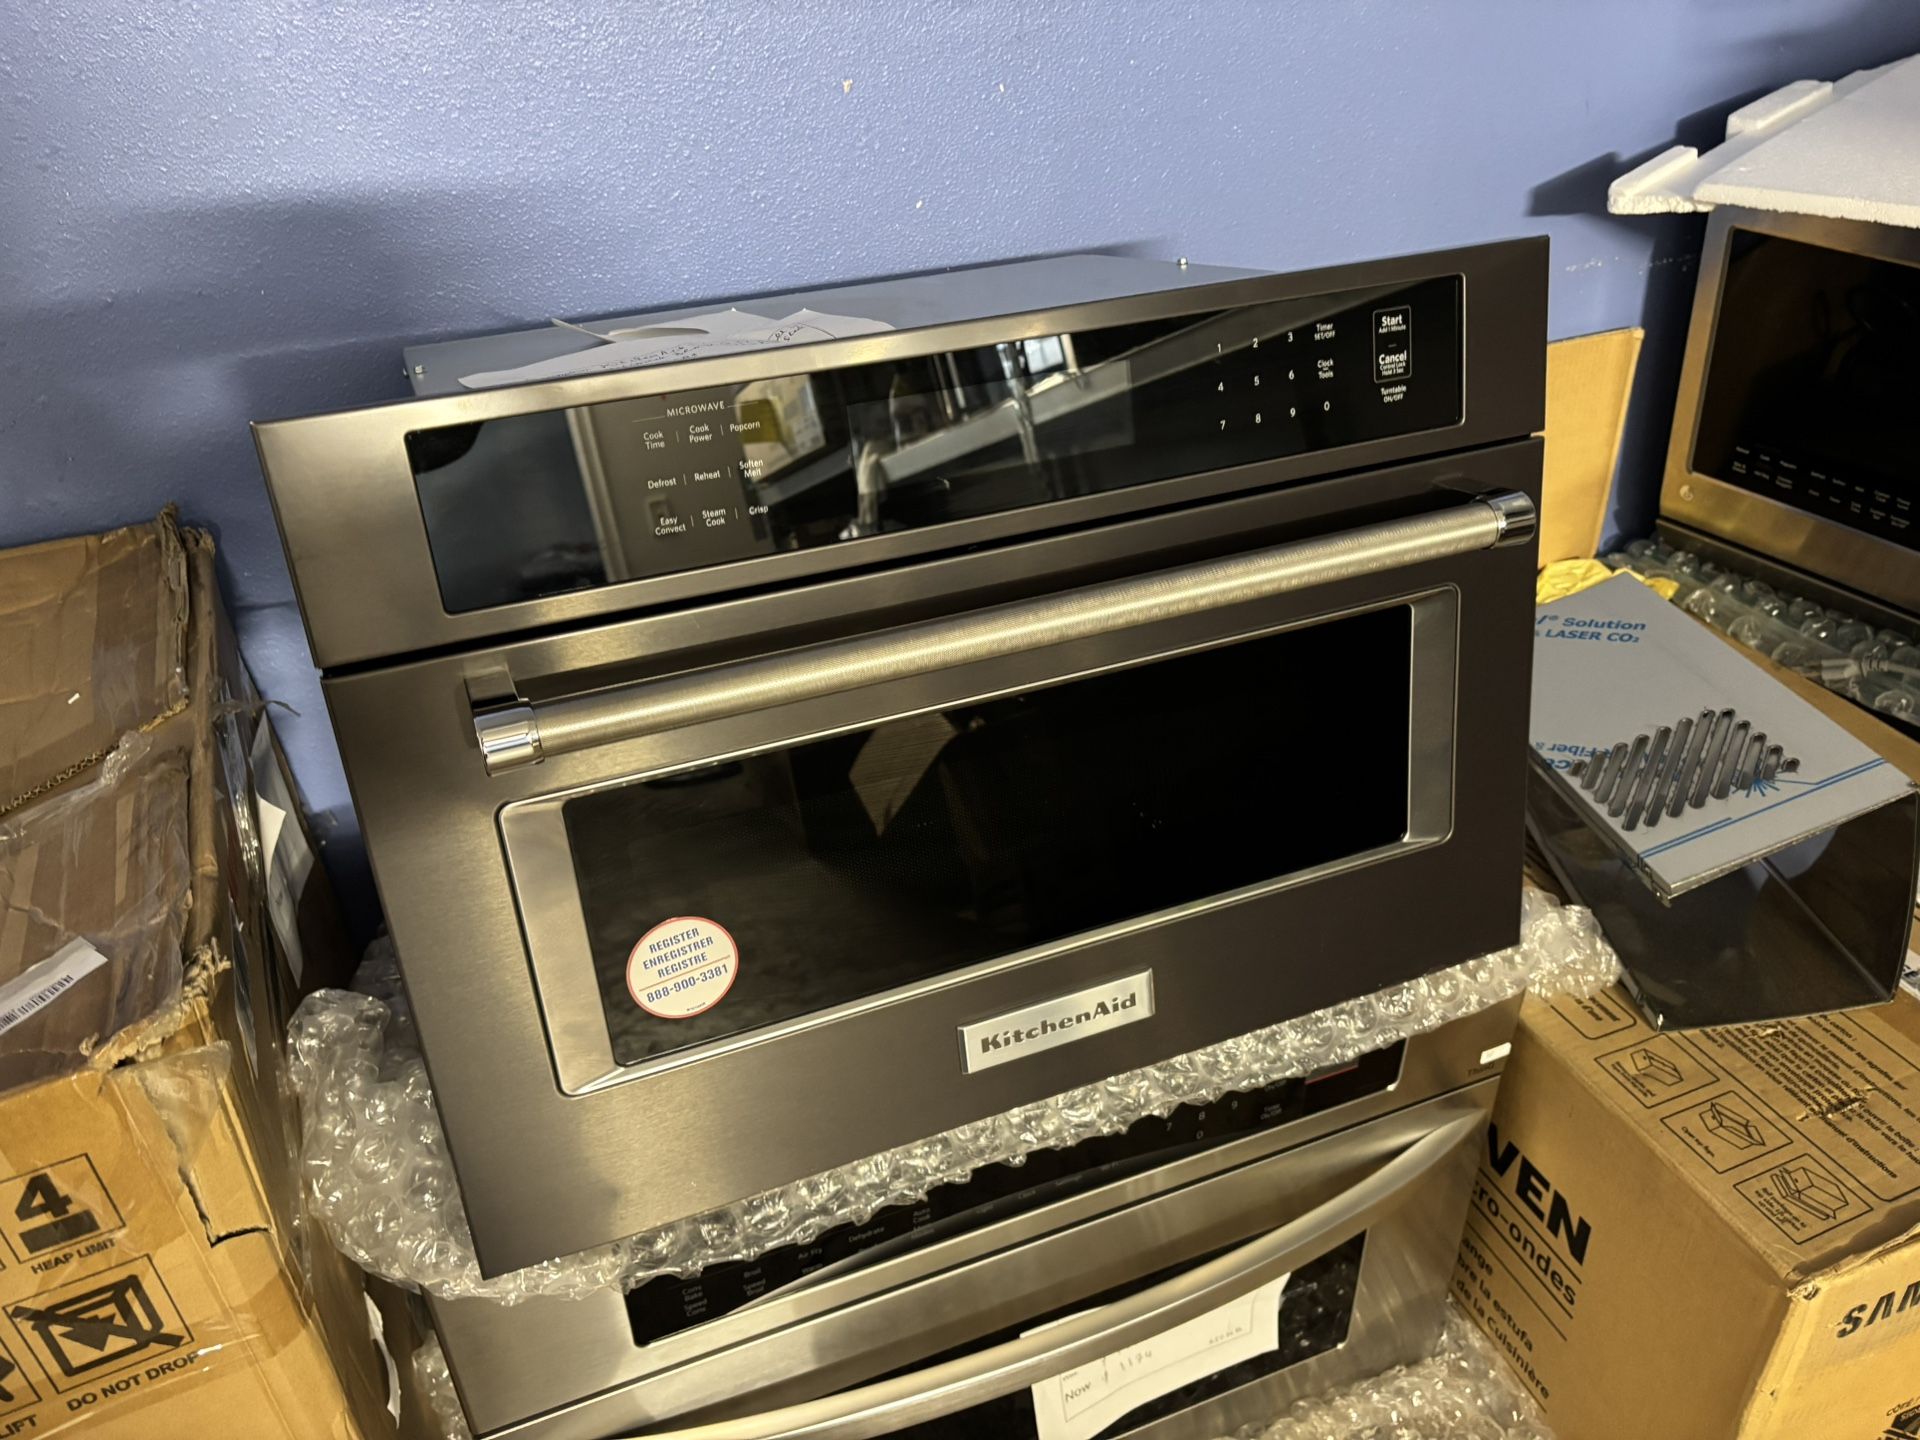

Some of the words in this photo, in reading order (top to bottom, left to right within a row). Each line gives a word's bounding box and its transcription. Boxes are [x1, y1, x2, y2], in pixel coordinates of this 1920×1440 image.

[1381, 314, 1403, 327] Start
[1316, 323, 1333, 332] Timer
[1252, 338, 1259, 348] 2
[1287, 331, 1294, 343] 3
[1217, 343, 1222, 353] 1
[1317, 358, 1334, 369] Clock
[1378, 349, 1408, 365] Cancel
[1253, 376, 1260, 386] 5
[1288, 370, 1295, 380] 6
[1318, 370, 1334, 379] Tools
[1217, 382, 1224, 392] 4
[666, 401, 725, 418] MICROWAVE
[1289, 407, 1296, 418] 9
[1323, 401, 1330, 411] 0
[1255, 413, 1262, 424] 8
[689, 423, 710, 435] Cook
[729, 420, 761, 434] Popcorn
[1219, 420, 1226, 431] 7
[643, 430, 664, 442] Cook
[689, 434, 713, 444] Power
[645, 440, 666, 451] Time
[739, 458, 764, 471] Soften
[694, 471, 721, 482] Reheat
[744, 468, 762, 479] Melt
[647, 477, 677, 490] Defrost
[702, 507, 726, 520] Steam
[748, 504, 769, 517] Crisp
[659, 515, 678, 526] Easy
[705, 517, 725, 528] Cook
[655, 523, 687, 537] Convect
[1562, 617, 1646, 631] Solution
[1545, 629, 1602, 642] LASER
[649, 927, 700, 954] REGISTER
[642, 936, 714, 971] ENREGISTRER
[657, 951, 708, 979] REGISTRE
[646, 963, 729, 1003] 888-900-3381
[980, 992, 1137, 1054] KitchenAid
[14, 1172, 73, 1222] 4
[1488, 1122, 1592, 1267] VEN
[31, 1252, 74, 1275] HEAP
[77, 1238, 116, 1259] LIMIT
[1479, 1279, 1492, 1300] la
[1493, 1299, 1533, 1352] estufa
[1473, 1297, 1485, 1318] la
[1487, 1316, 1549, 1399] Cuisinière
[66, 1390, 98, 1411] DO
[101, 1373, 142, 1398] NOT
[145, 1350, 201, 1379] DROP
[1065, 1381, 1092, 1403] Now
